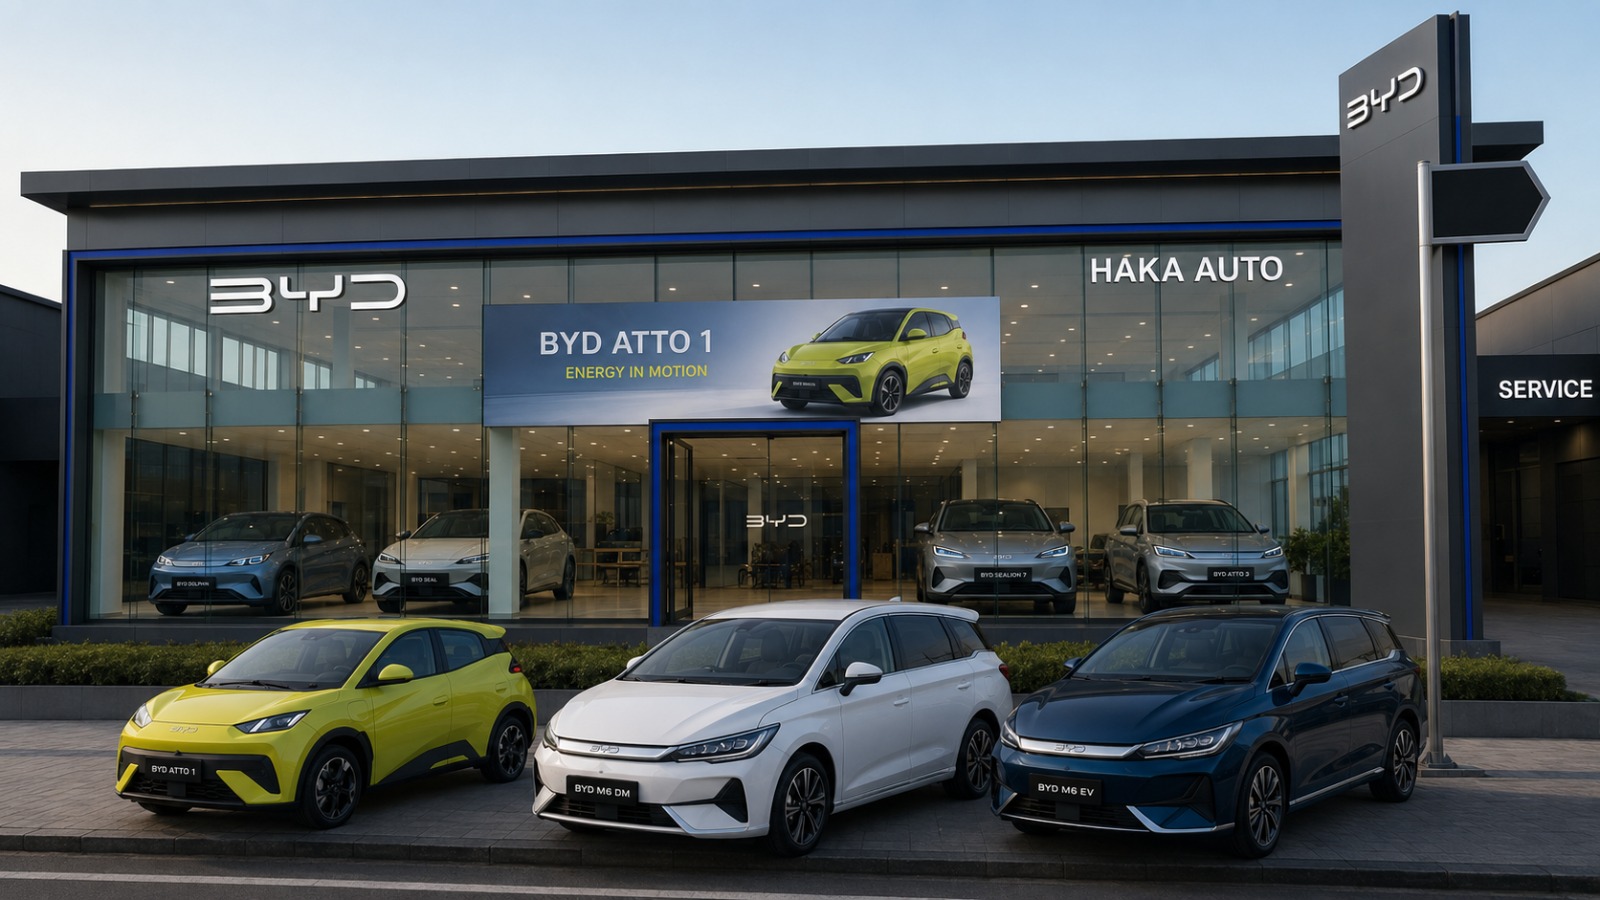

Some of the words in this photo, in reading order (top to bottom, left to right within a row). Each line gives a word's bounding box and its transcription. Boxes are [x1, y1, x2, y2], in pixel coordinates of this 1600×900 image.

[1347, 66, 1423, 129] BYD
[1090, 257, 1185, 283] HAKA
[1194, 255, 1284, 282] AUTO
[210, 273, 407, 315] BYD
[540, 331, 602, 355] BYD
[612, 329, 691, 354] ATTO
[700, 329, 711, 353] 1
[566, 366, 625, 379] ENERGY
[629, 365, 644, 378] IN
[649, 364, 708, 378] MOTION
[1498, 379, 1593, 399] SERVICE
[746, 514, 808, 528] BYD
[151, 765, 168, 773] BYD
[168, 766, 190, 775] ATTO
[192, 768, 196, 776] 1
[574, 784, 595, 793] BYD
[596, 786, 612, 796] M6
[614, 789, 631, 798] DM
[1037, 783, 1059, 793] BYD
[1061, 786, 1078, 795] M6
[1080, 787, 1094, 797] EV
